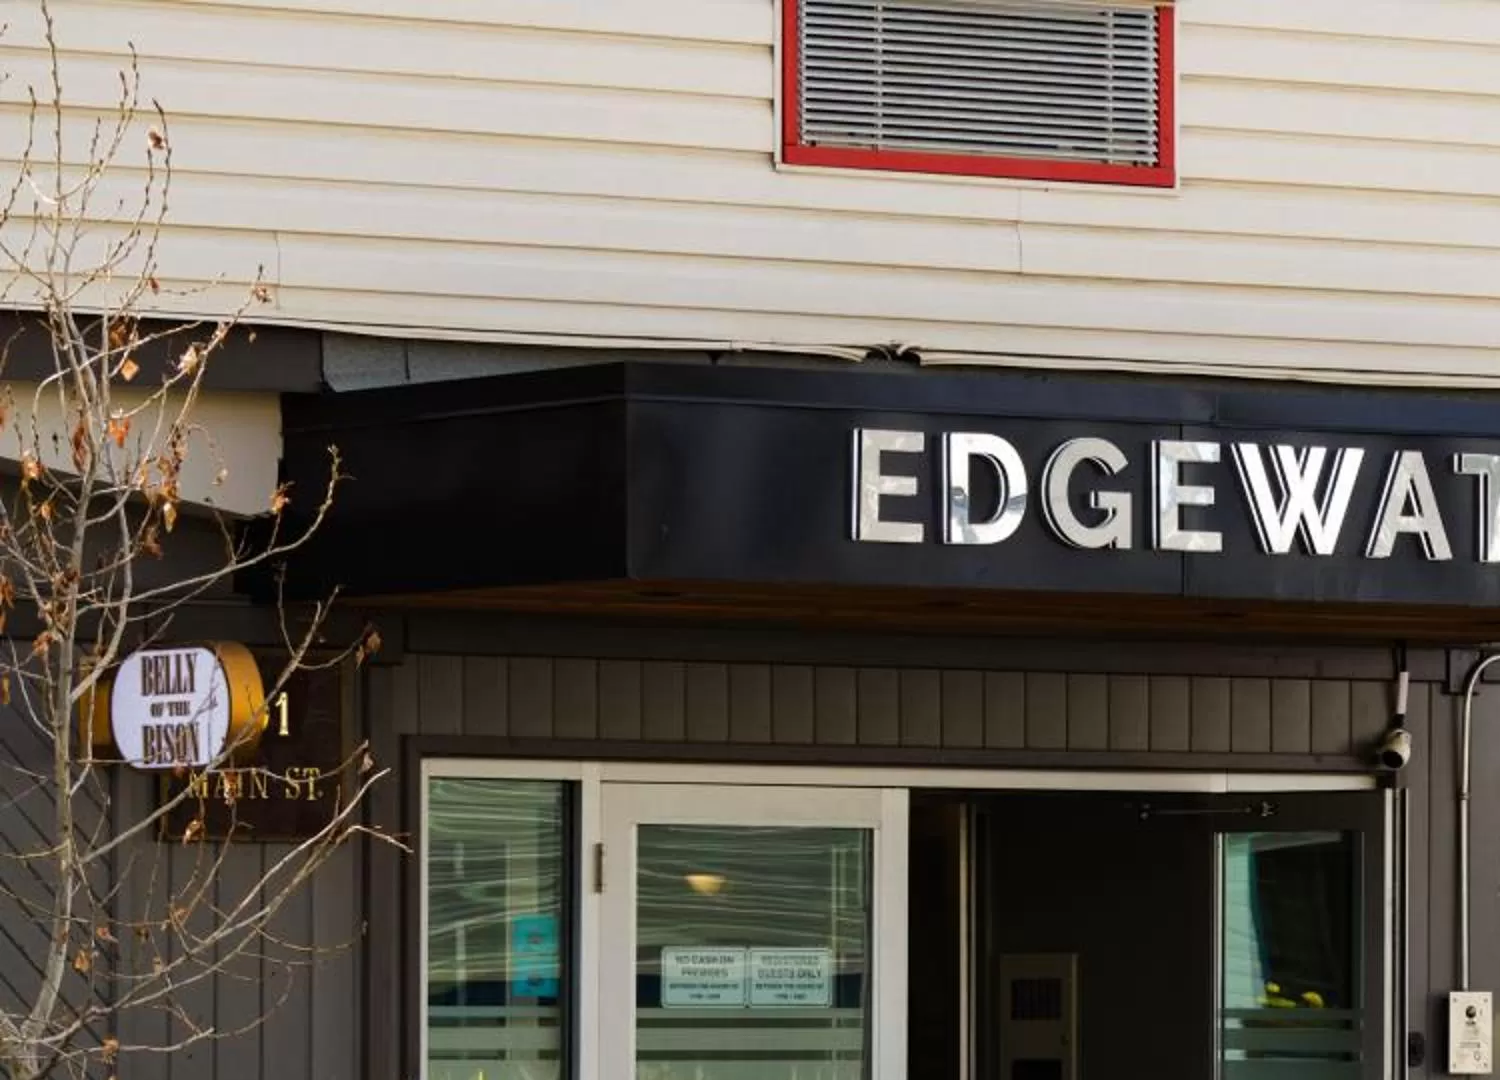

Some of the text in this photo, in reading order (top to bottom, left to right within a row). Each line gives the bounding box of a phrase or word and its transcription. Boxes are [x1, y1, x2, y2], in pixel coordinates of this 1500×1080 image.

[141, 653, 198, 696] BELLY
[150, 700, 190, 717] OF THE
[142, 722, 200, 764] BISON
[188, 767, 269, 799] MAIN
